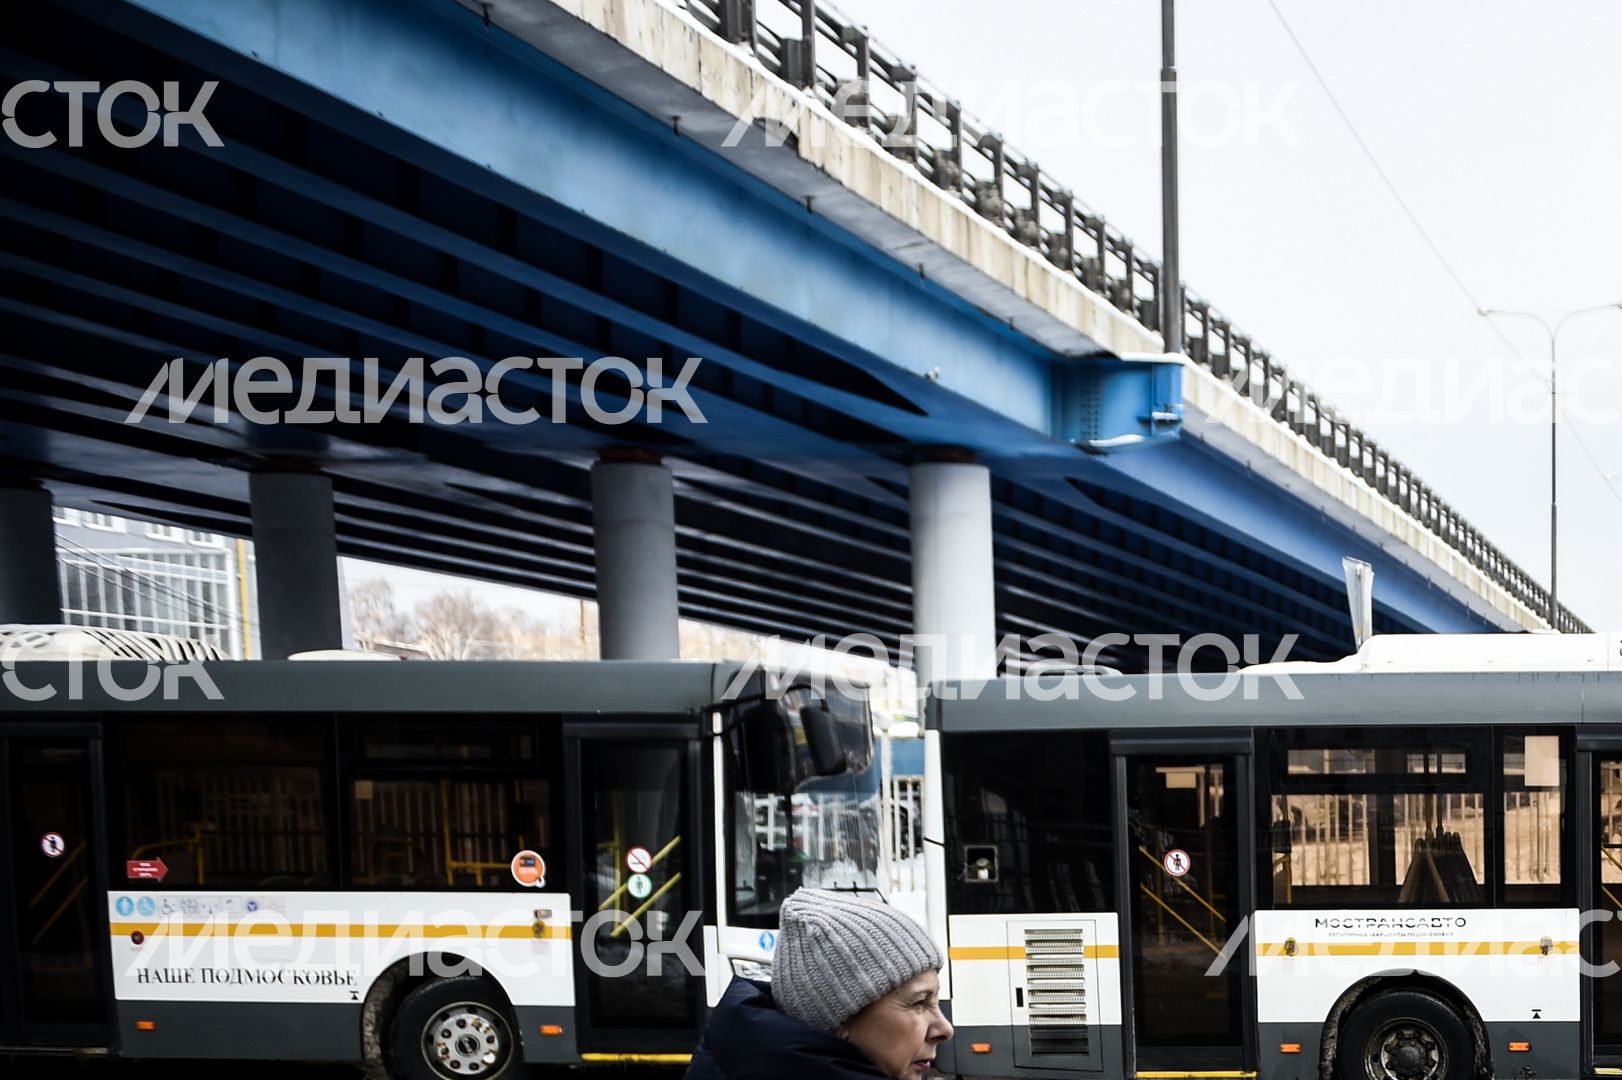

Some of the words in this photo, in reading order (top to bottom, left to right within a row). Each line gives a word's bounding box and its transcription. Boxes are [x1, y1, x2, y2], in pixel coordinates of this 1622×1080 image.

[1315, 918, 1467, 929] МОСТРАНСАВТО
[137, 967, 195, 985] НАШЕ
[202, 967, 358, 986] ПОДМОСКОВЬЕ
